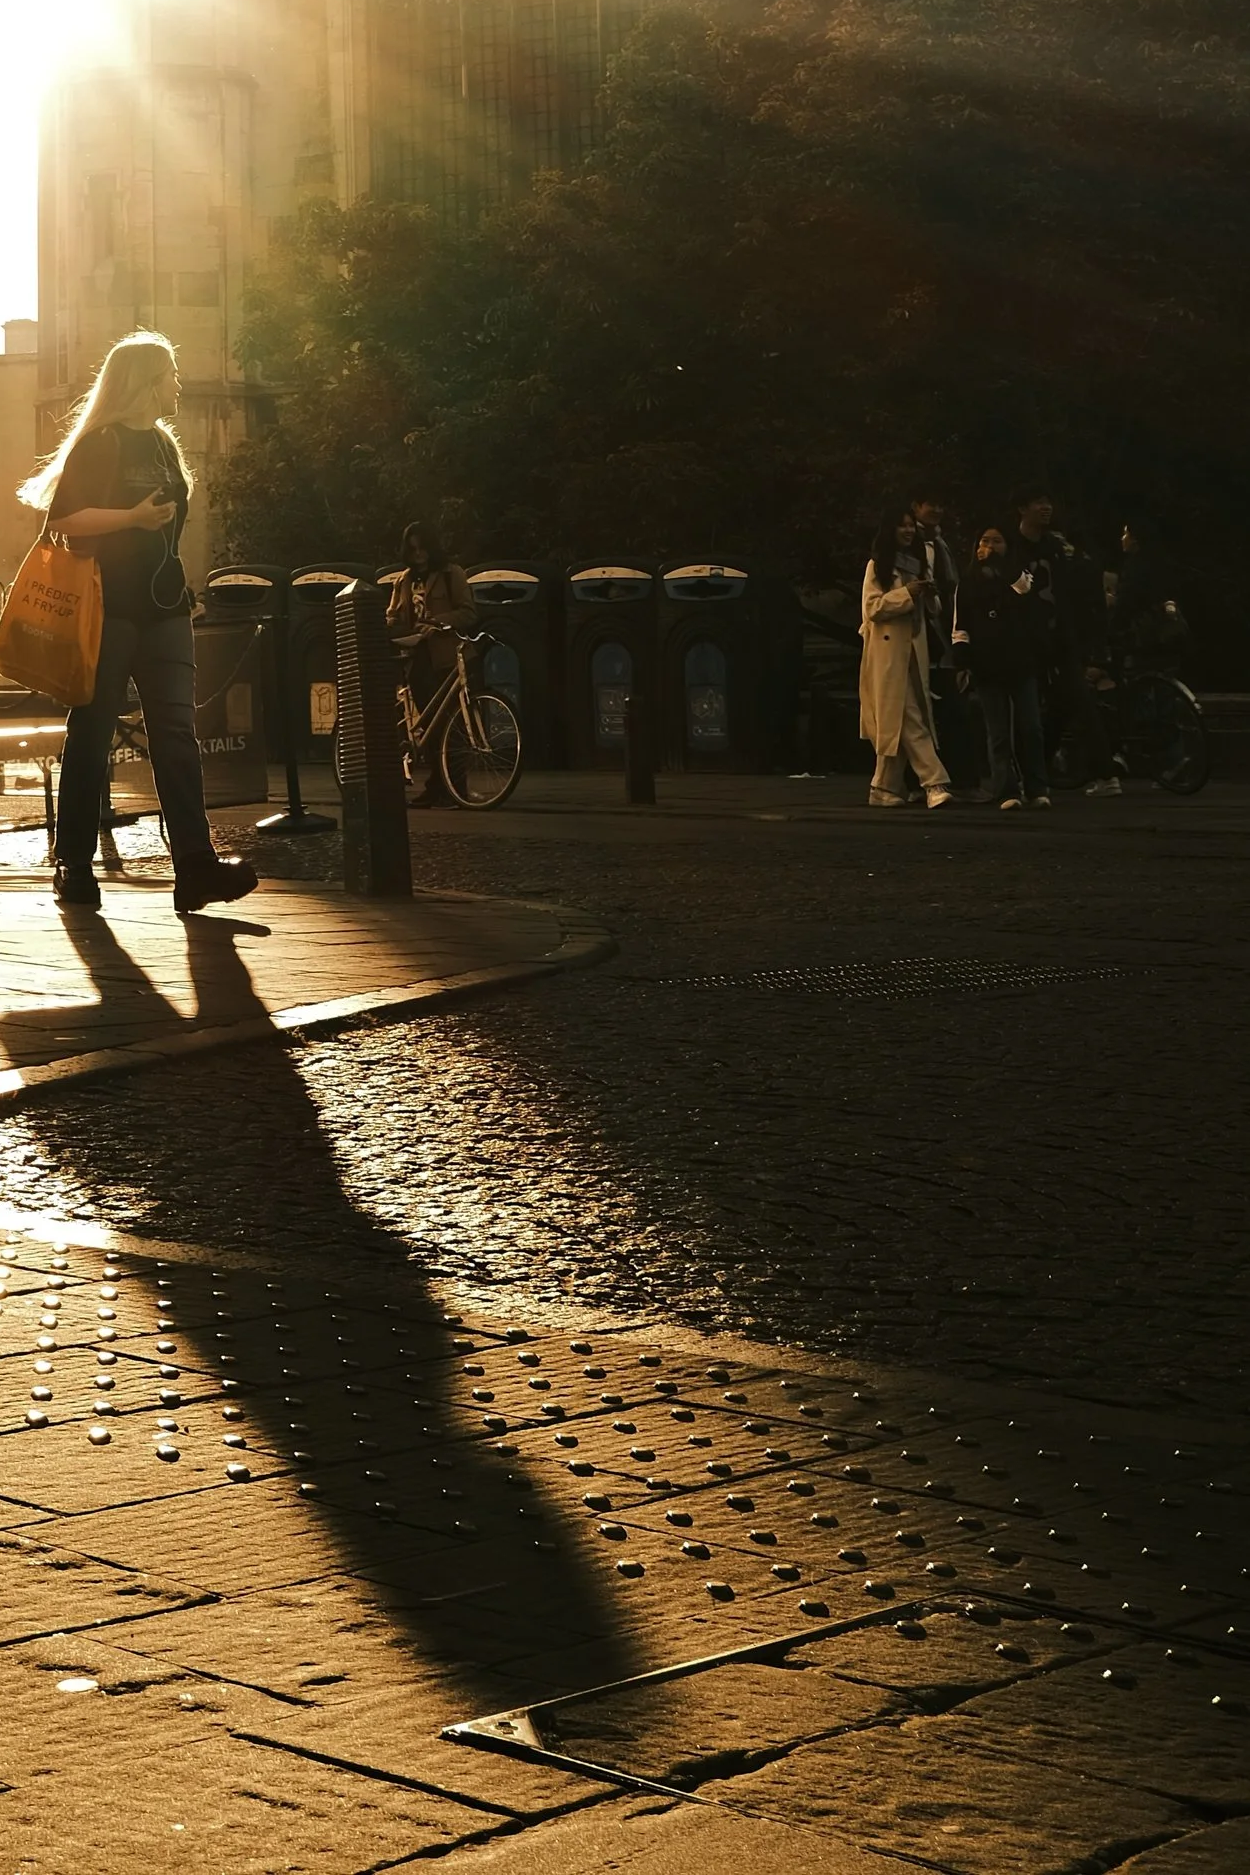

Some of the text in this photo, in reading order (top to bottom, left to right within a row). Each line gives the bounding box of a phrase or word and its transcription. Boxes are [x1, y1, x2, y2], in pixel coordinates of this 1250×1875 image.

[31, 581, 81, 604] PREDICT
[22, 594, 74, 618] A FRY-UP
